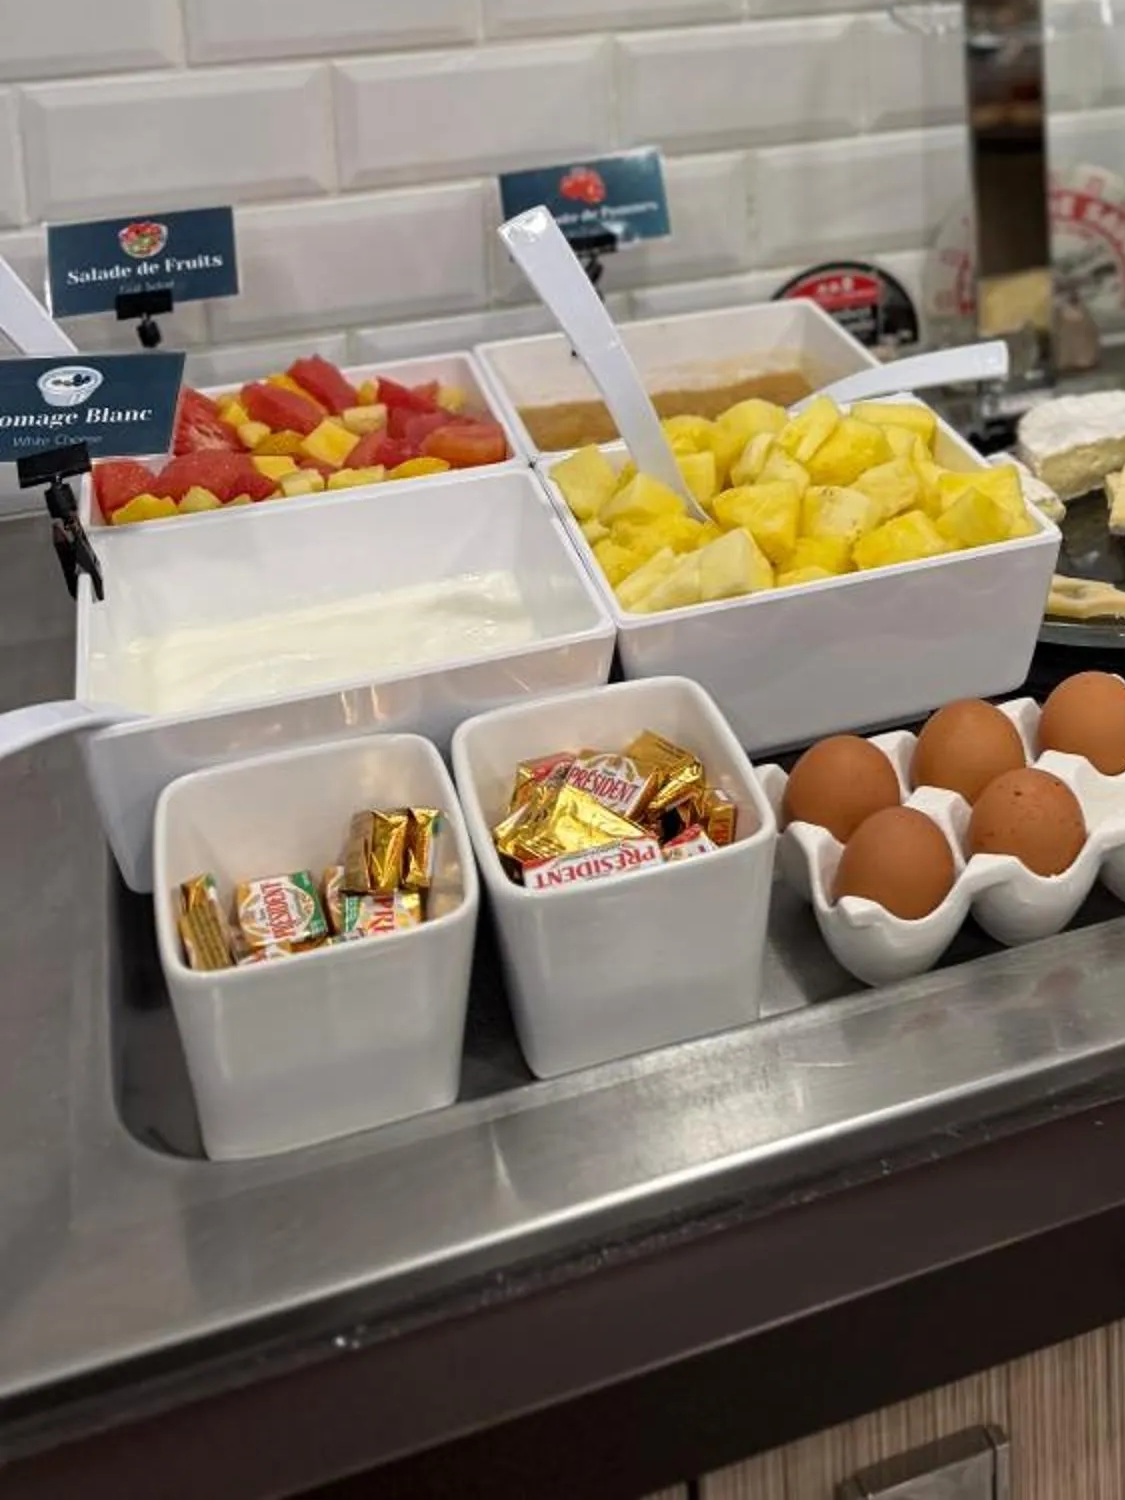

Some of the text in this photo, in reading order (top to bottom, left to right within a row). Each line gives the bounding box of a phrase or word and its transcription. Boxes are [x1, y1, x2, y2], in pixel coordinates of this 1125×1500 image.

[66, 253, 224, 286] Salade de Fruits
[0, 407, 153, 428] omage Blanc
